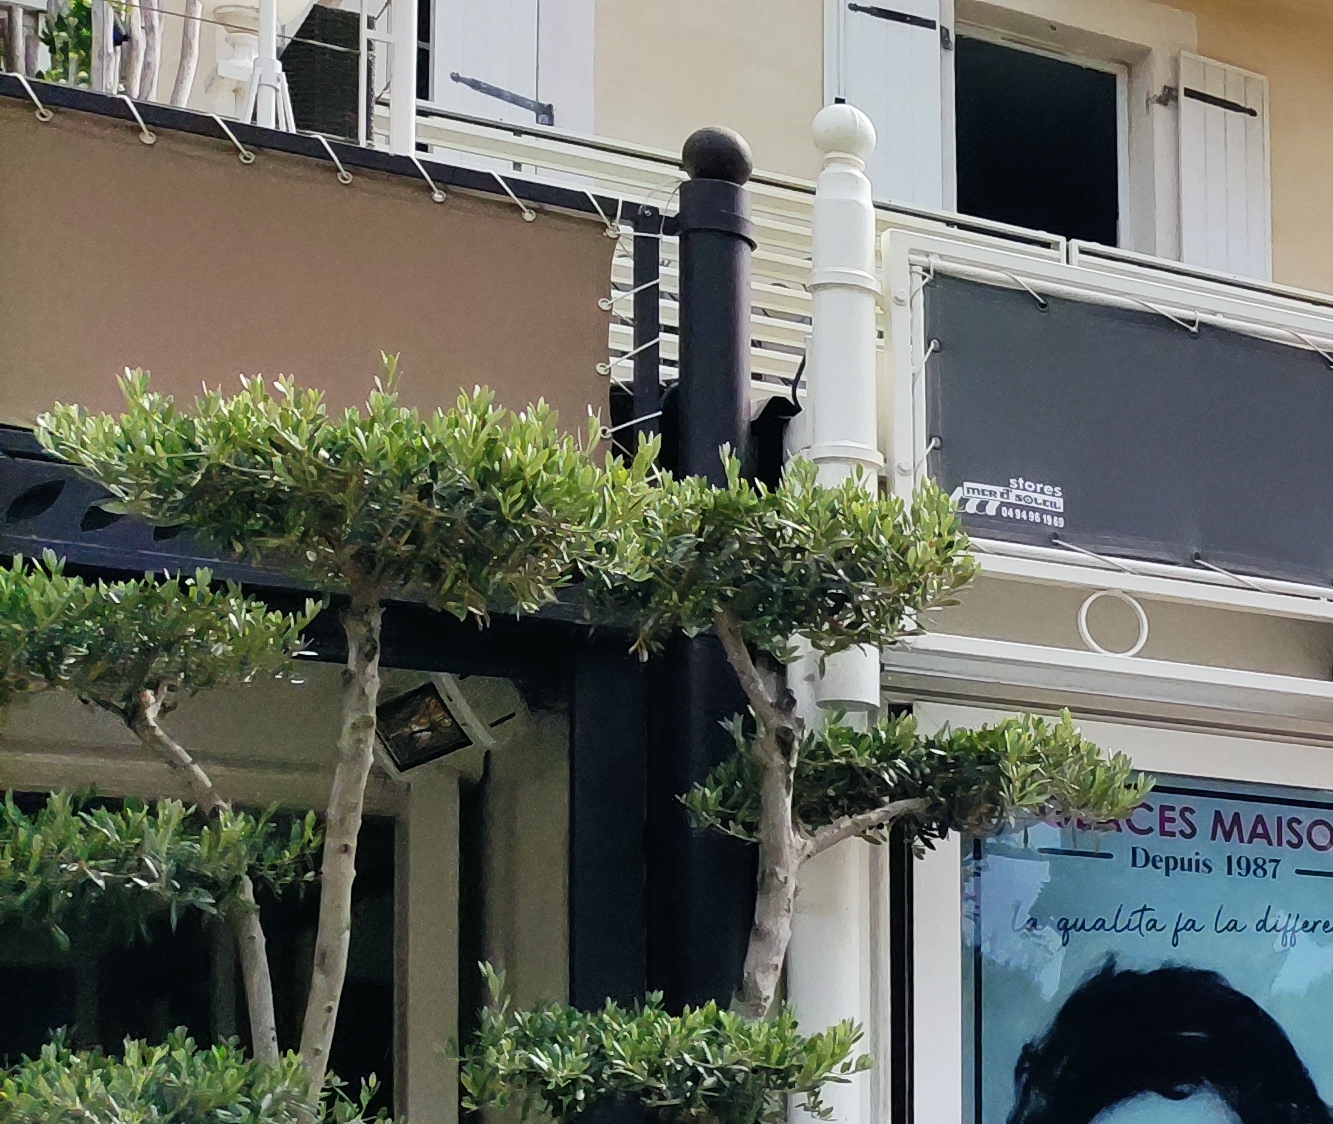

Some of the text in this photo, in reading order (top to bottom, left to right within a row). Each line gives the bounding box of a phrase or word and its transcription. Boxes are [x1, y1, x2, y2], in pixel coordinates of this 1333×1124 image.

[1009, 477, 1062, 497] stores
[1001, 506, 1014, 519] 04
[1015, 507, 1028, 521] 94
[1028, 510, 1041, 523] 96
[1130, 846, 1282, 880] Depuis 1987
[1171, 911, 1206, 948] fa
[1213, 904, 1248, 933] la
